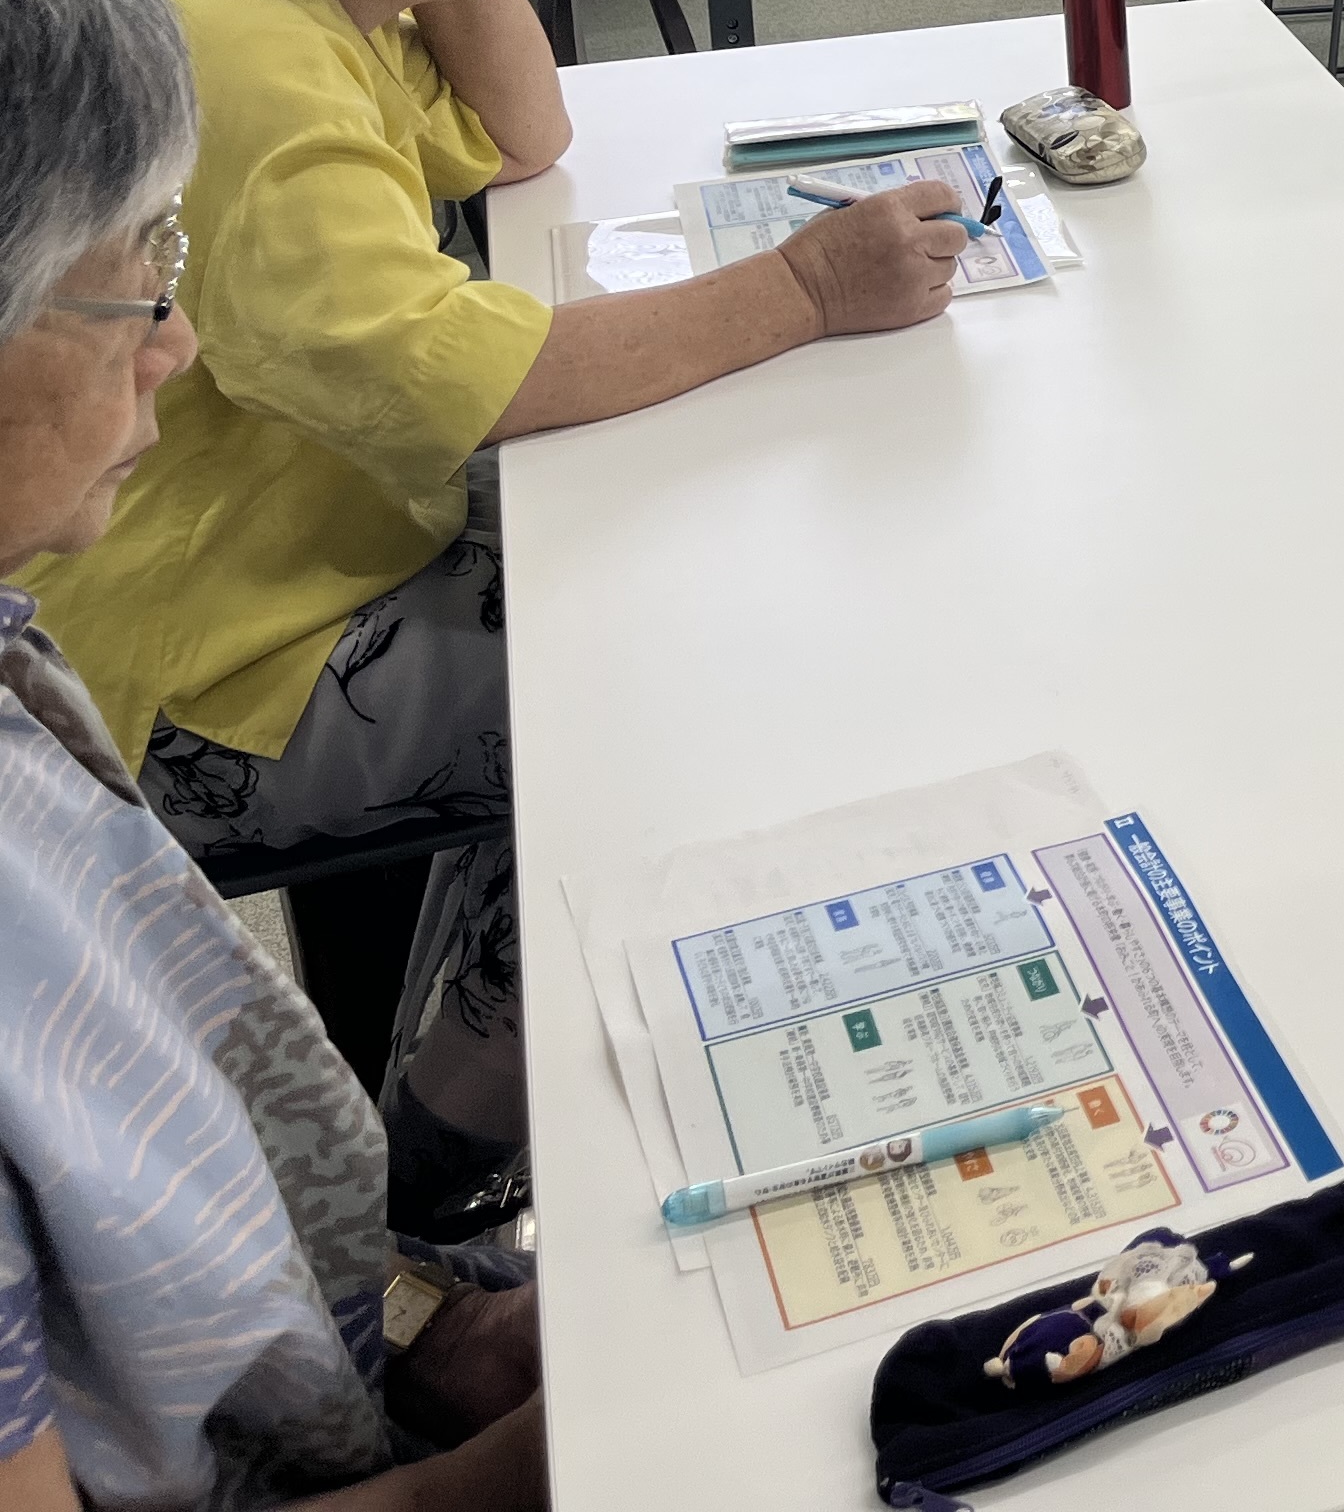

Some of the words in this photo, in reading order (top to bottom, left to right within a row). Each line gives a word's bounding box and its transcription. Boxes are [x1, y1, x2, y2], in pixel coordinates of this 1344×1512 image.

[1122, 830, 1225, 977] 一般会計の主要事業のポイント
